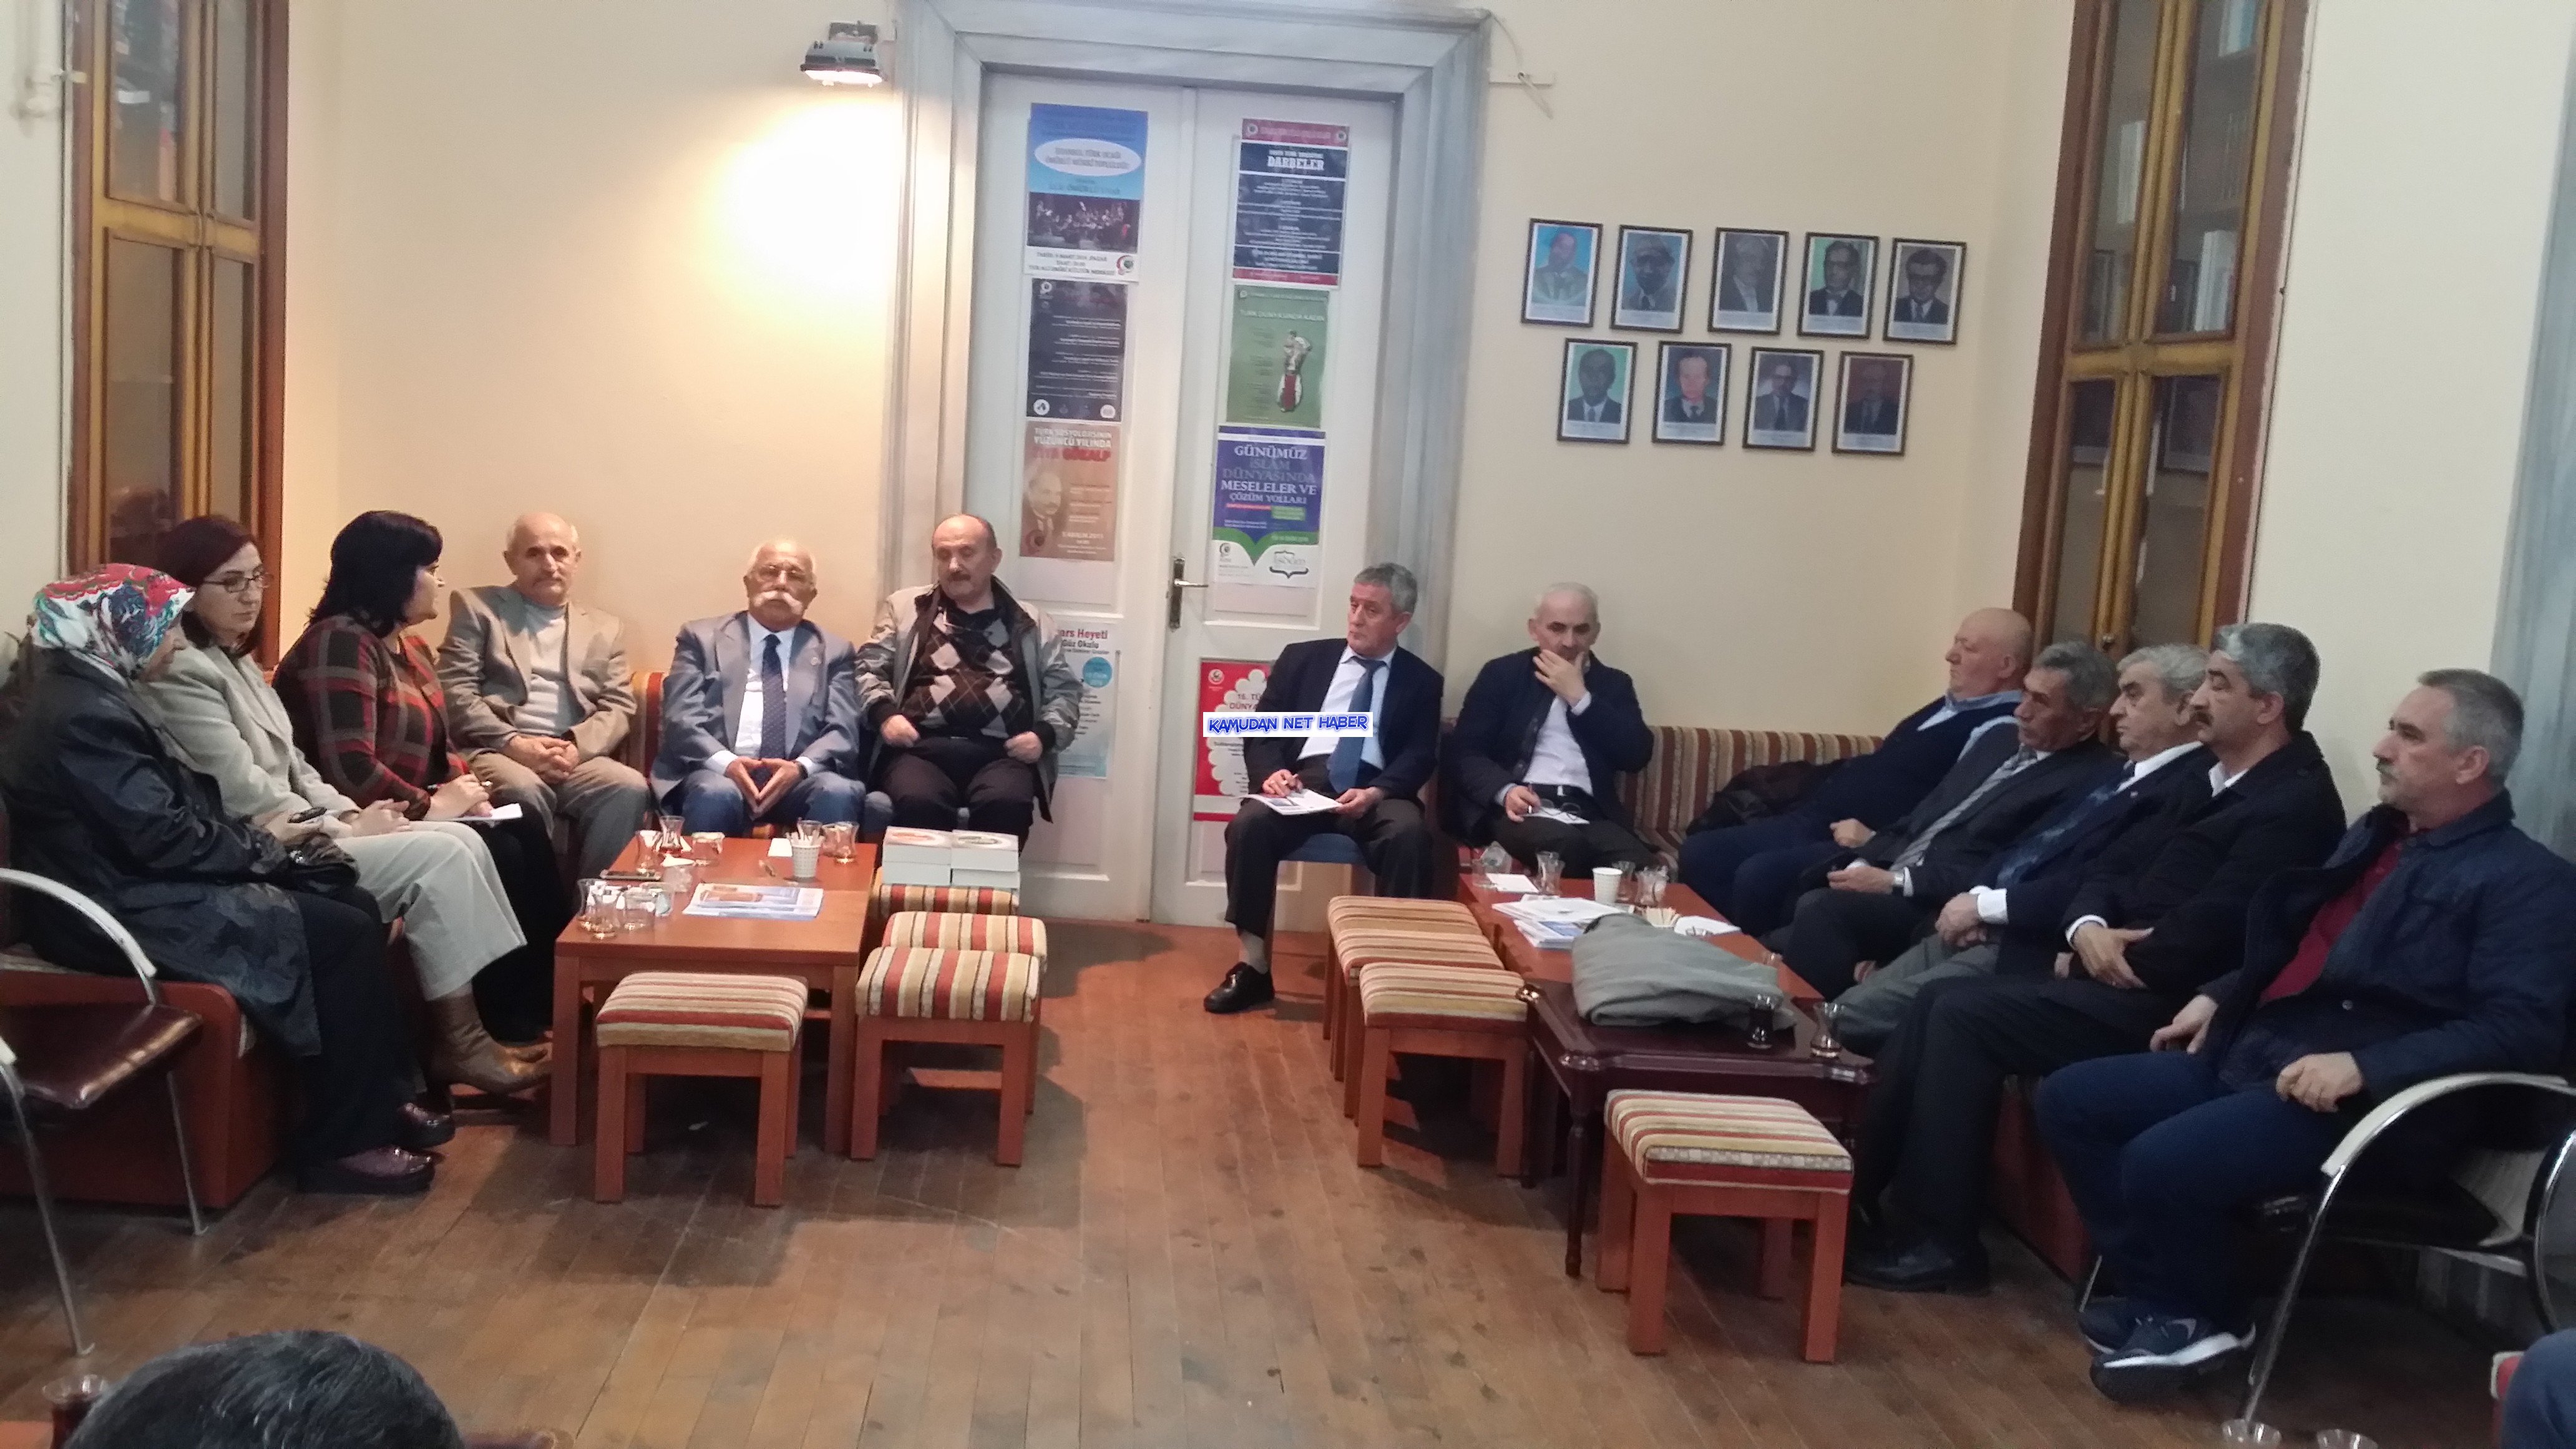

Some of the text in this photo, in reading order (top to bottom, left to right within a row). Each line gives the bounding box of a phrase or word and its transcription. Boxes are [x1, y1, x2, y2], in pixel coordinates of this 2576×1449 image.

[1234, 444, 1307, 459] GÜNÜMÜZ
[1222, 467, 1316, 483] DÜNYASINDA
[1221, 480, 1317, 495] MESELELER VE
[1229, 492, 1307, 504] ÇÖZÜM YOLLARI
